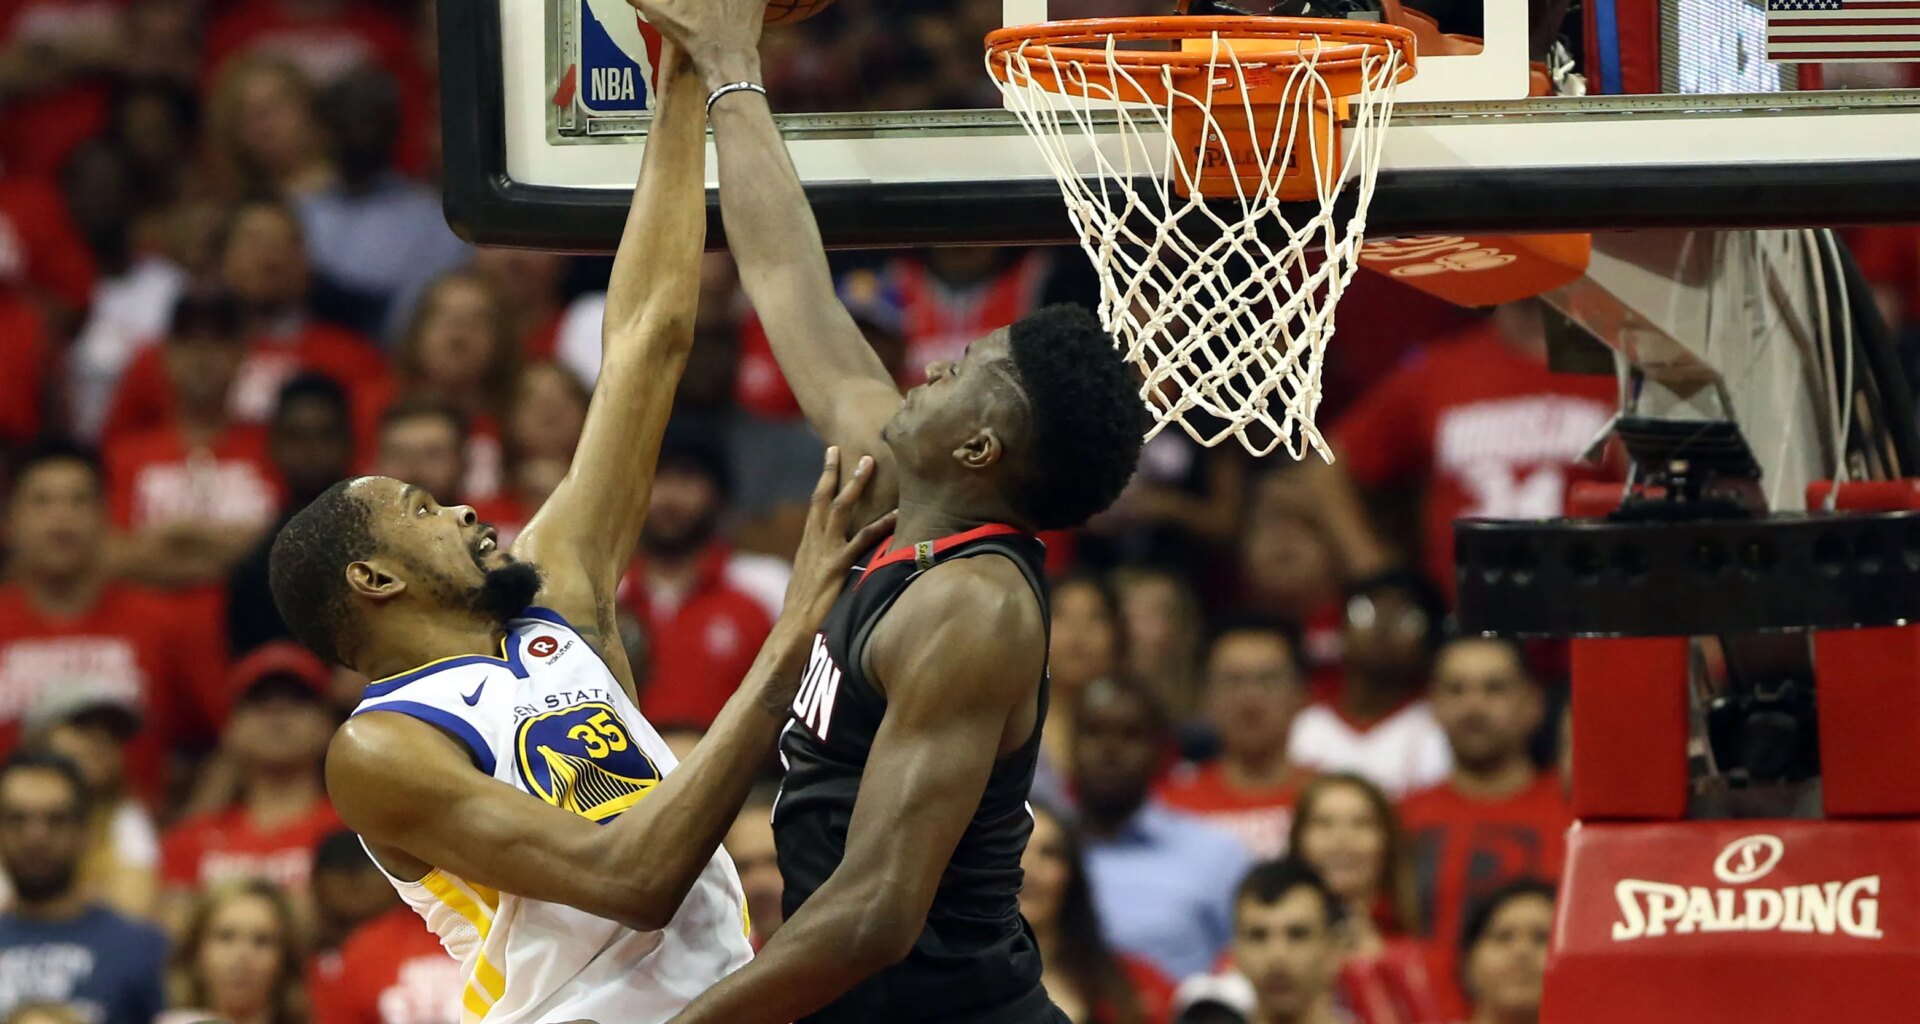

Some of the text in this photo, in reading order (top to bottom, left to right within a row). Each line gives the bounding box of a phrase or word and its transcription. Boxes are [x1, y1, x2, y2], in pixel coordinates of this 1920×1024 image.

[591, 67, 635, 100] NBA
[566, 710, 628, 758] 35
[1612, 875, 1884, 941] SPALDING
